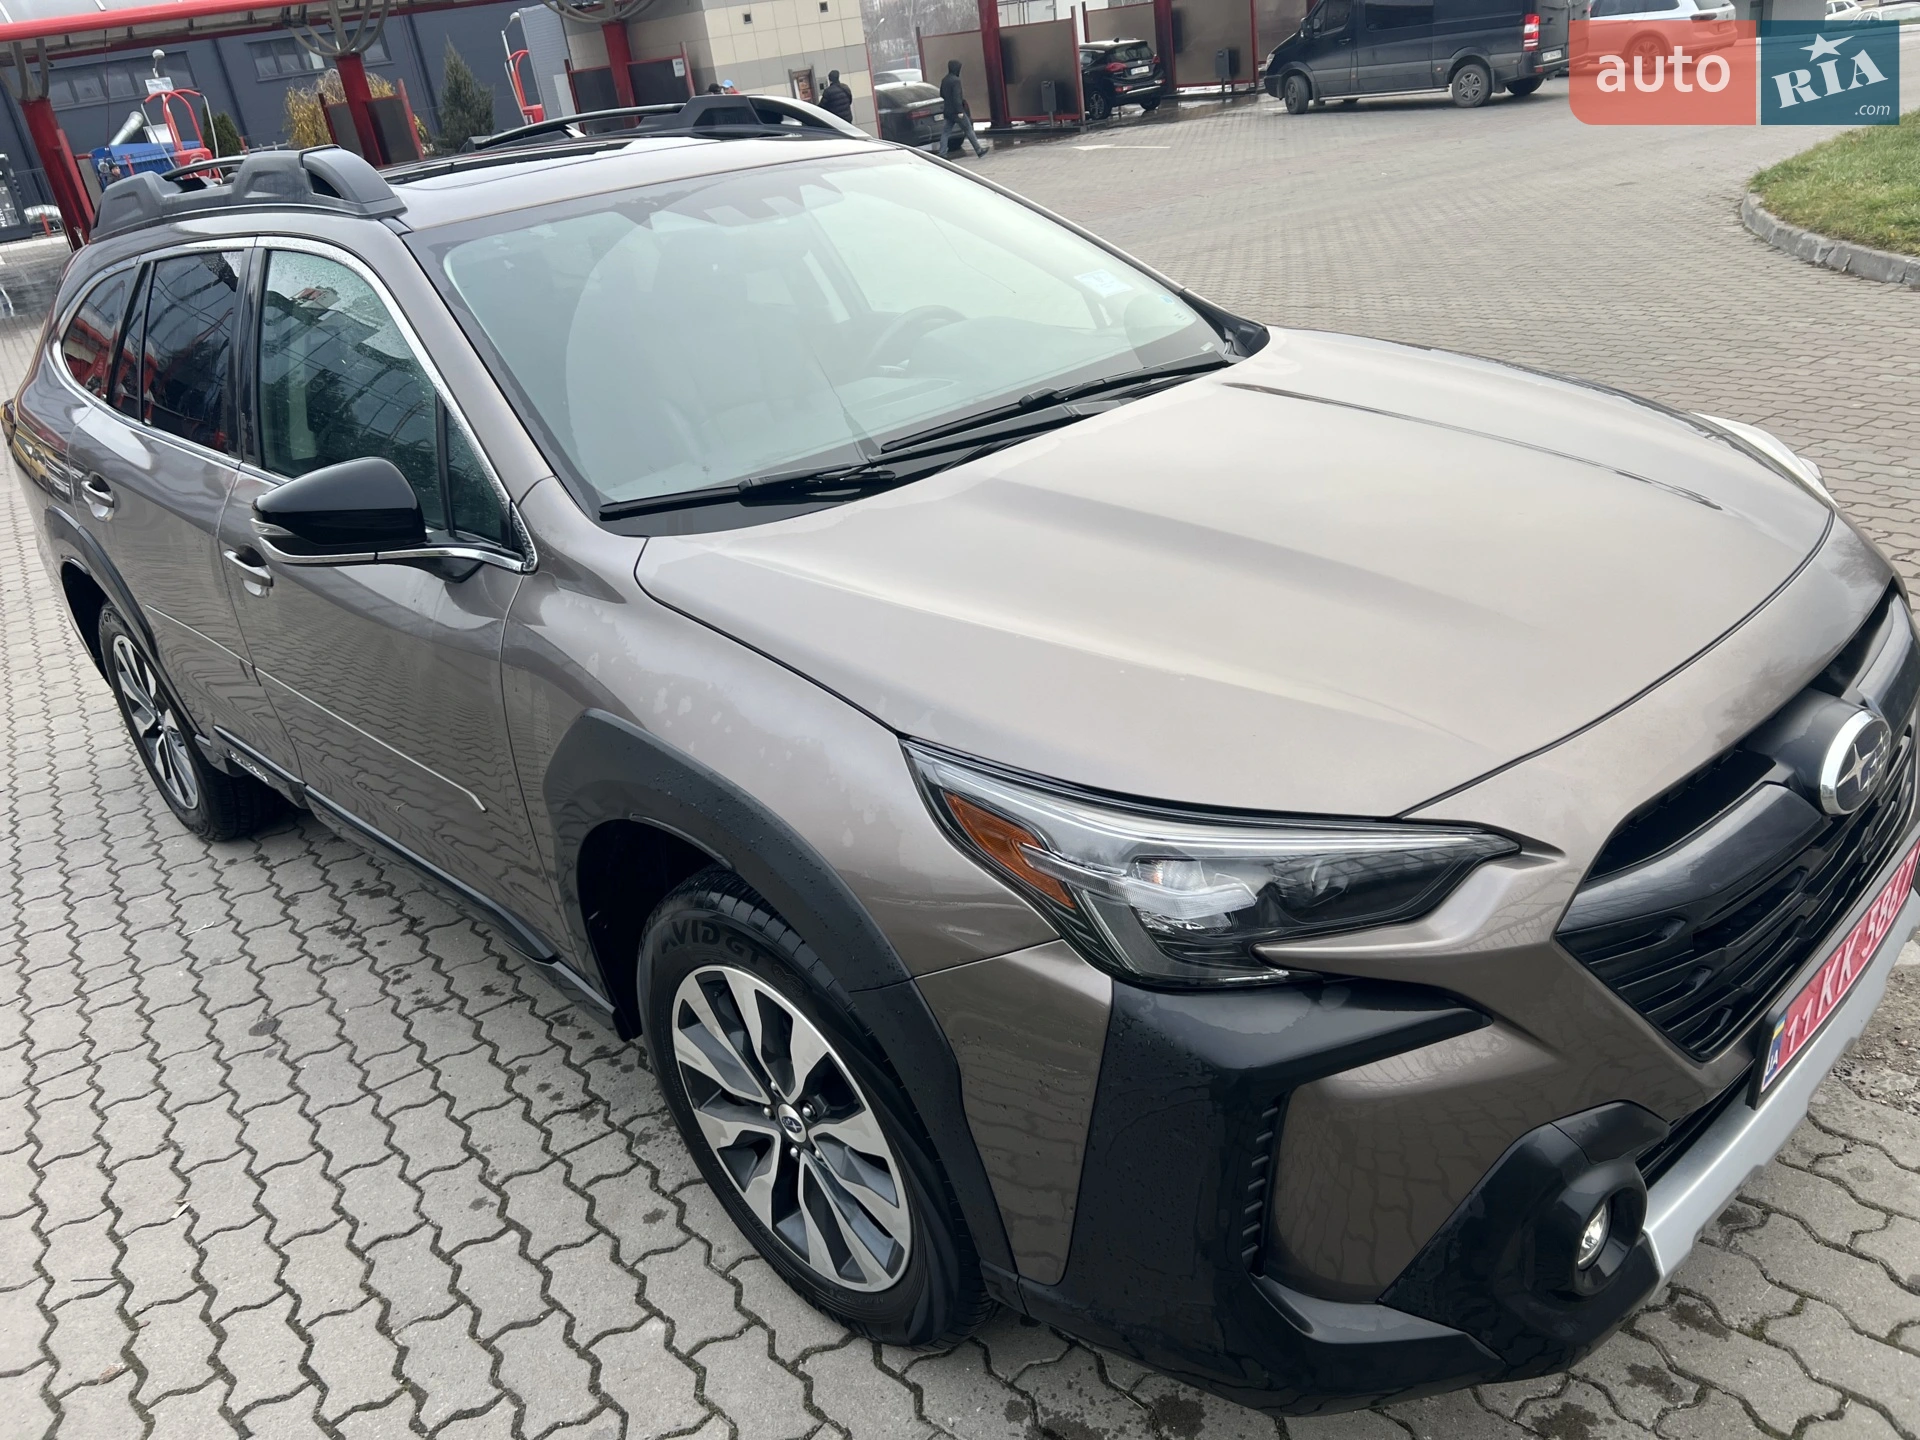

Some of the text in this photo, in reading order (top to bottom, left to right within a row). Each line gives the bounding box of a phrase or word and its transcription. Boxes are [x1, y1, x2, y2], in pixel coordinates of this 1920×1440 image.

[1862, 847, 1918, 958] 5867
[661, 919, 765, 966] AVID GT
[1765, 1047, 1779, 1077] UA
